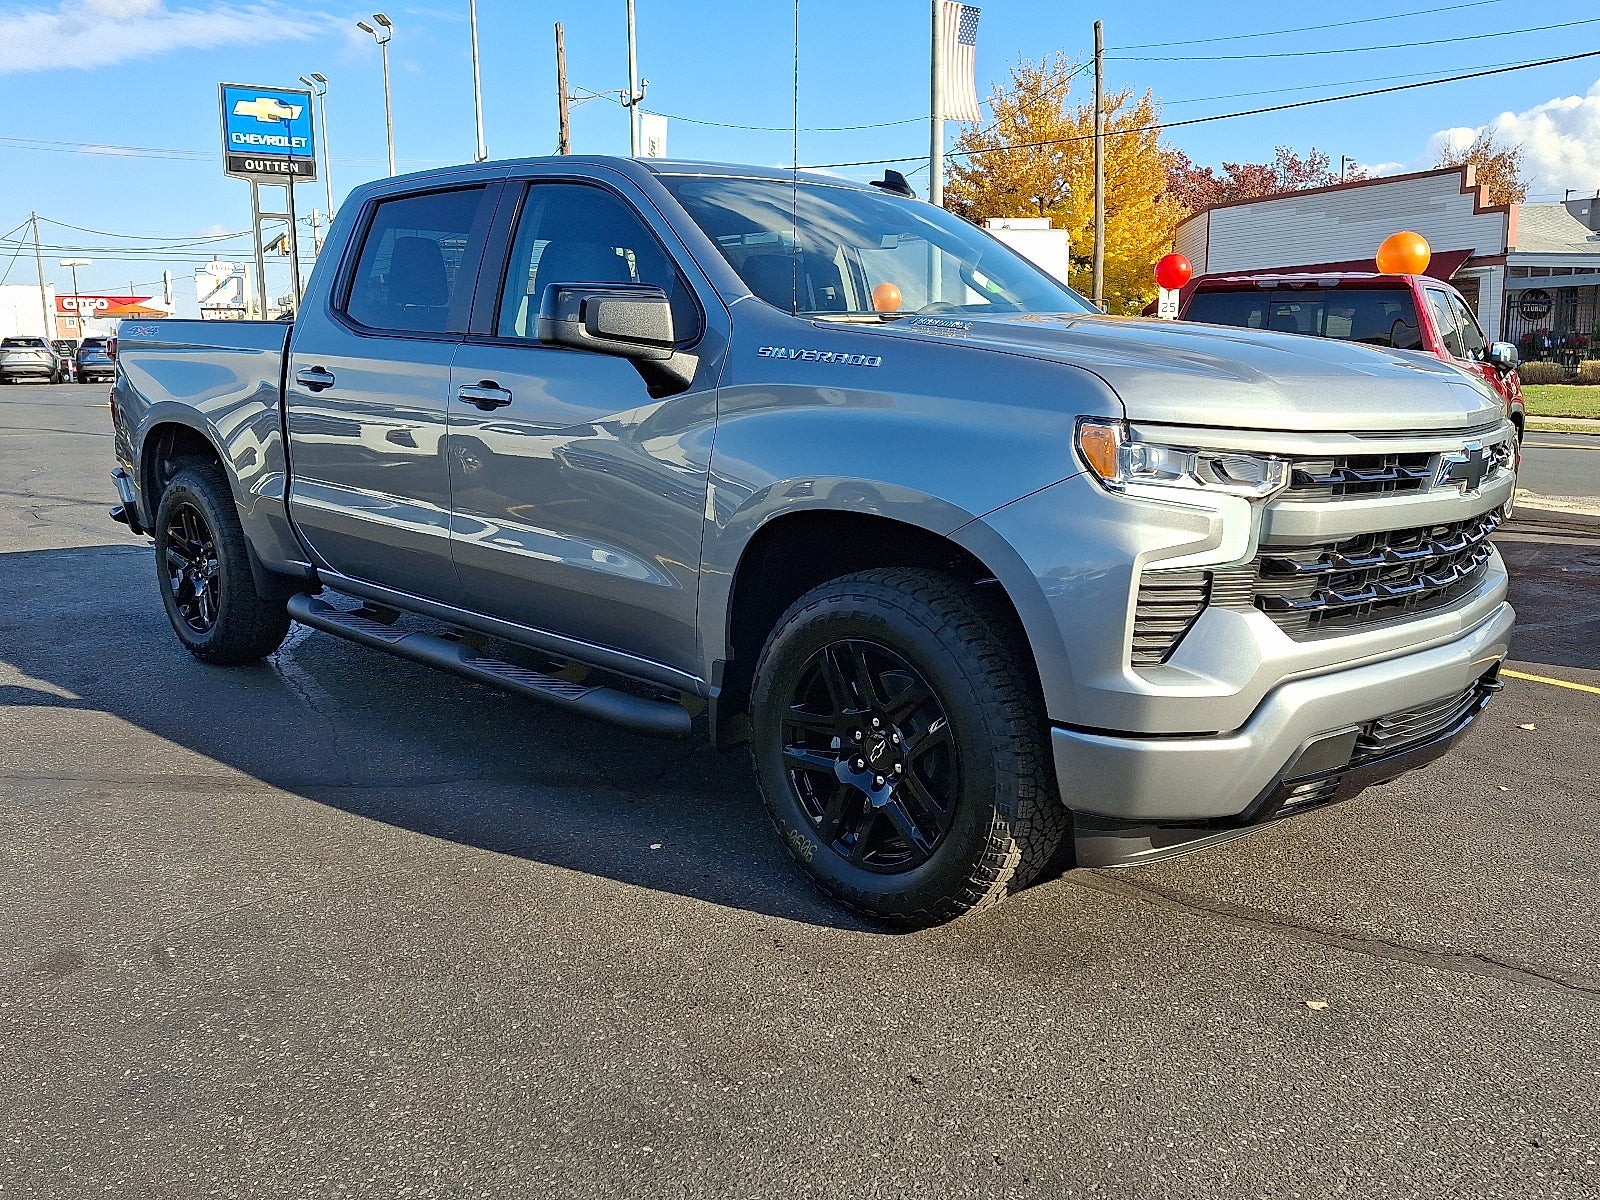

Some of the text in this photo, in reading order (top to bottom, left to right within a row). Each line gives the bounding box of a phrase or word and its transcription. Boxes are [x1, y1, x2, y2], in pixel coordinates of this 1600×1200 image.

[231, 132, 307, 148] CHEVROLET
[244, 159, 299, 173] OUTTEN
[1161, 302, 1176, 313] 25
[757, 346, 883, 367] SILVERADO
